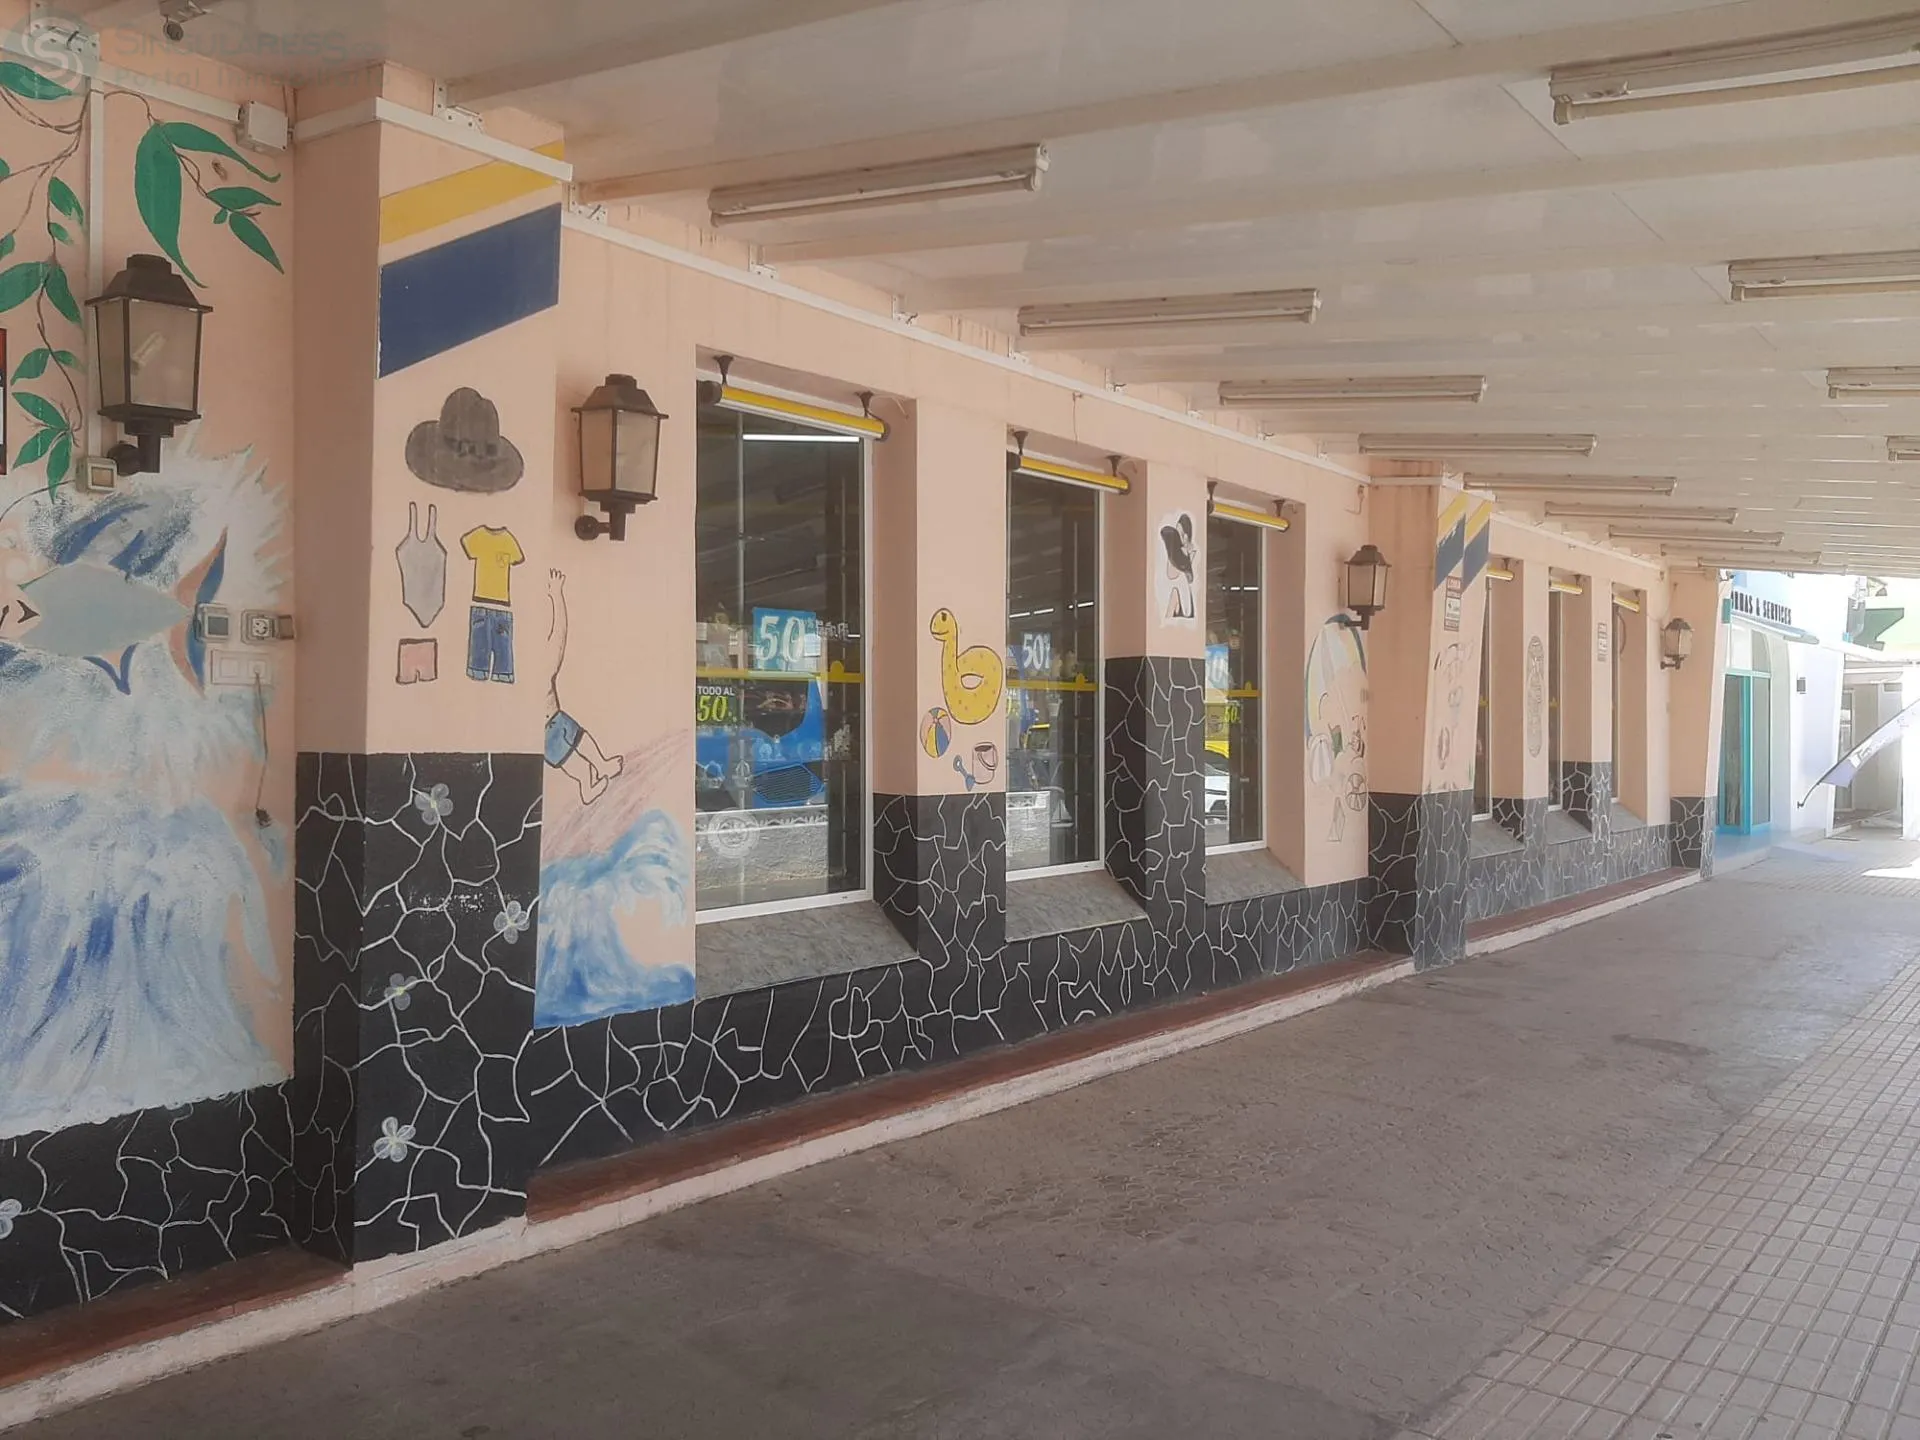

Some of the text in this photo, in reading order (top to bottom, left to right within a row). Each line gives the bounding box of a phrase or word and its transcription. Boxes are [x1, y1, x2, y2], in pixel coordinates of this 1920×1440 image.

[1763, 600, 1791, 625] SERVICES
[697, 686, 736, 696] TODO AL
